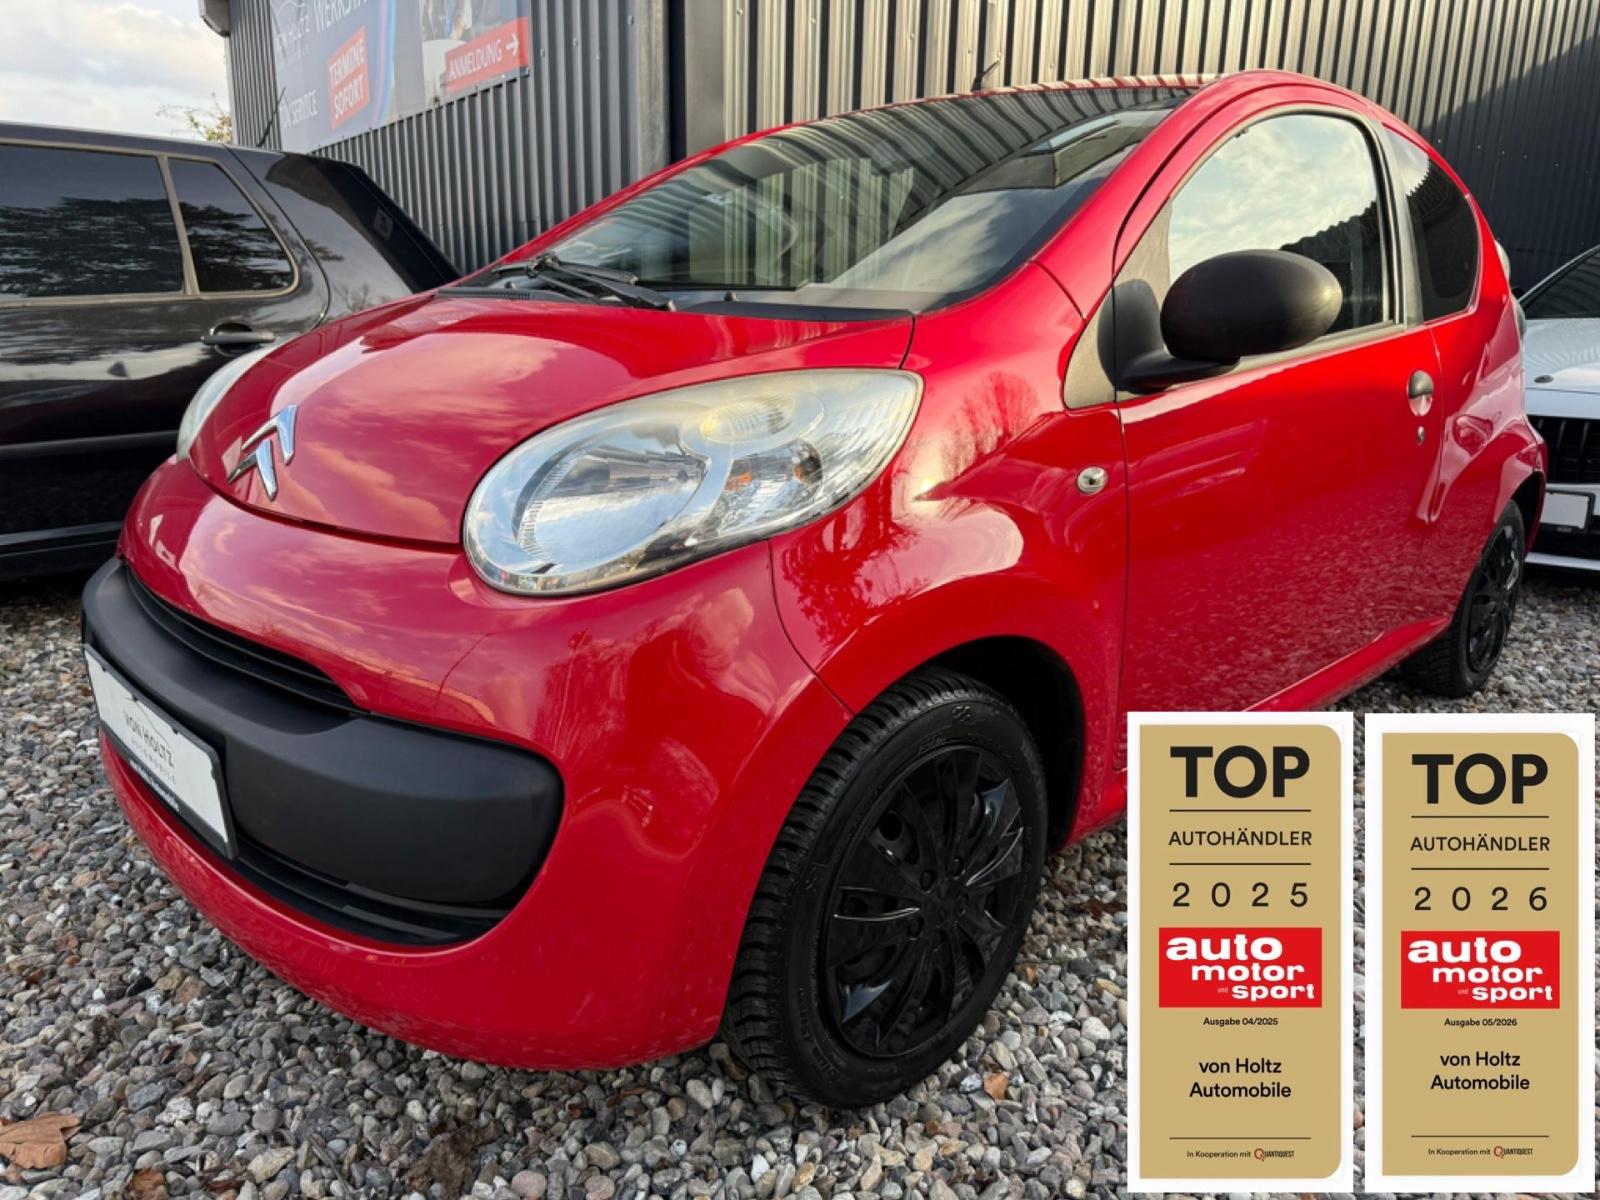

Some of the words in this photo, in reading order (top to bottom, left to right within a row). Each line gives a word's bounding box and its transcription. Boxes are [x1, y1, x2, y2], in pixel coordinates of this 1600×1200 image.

[329, 38, 365, 88] TERMINE
[448, 39, 502, 81] ANMELDUNG
[334, 73, 364, 119] SOFORT
